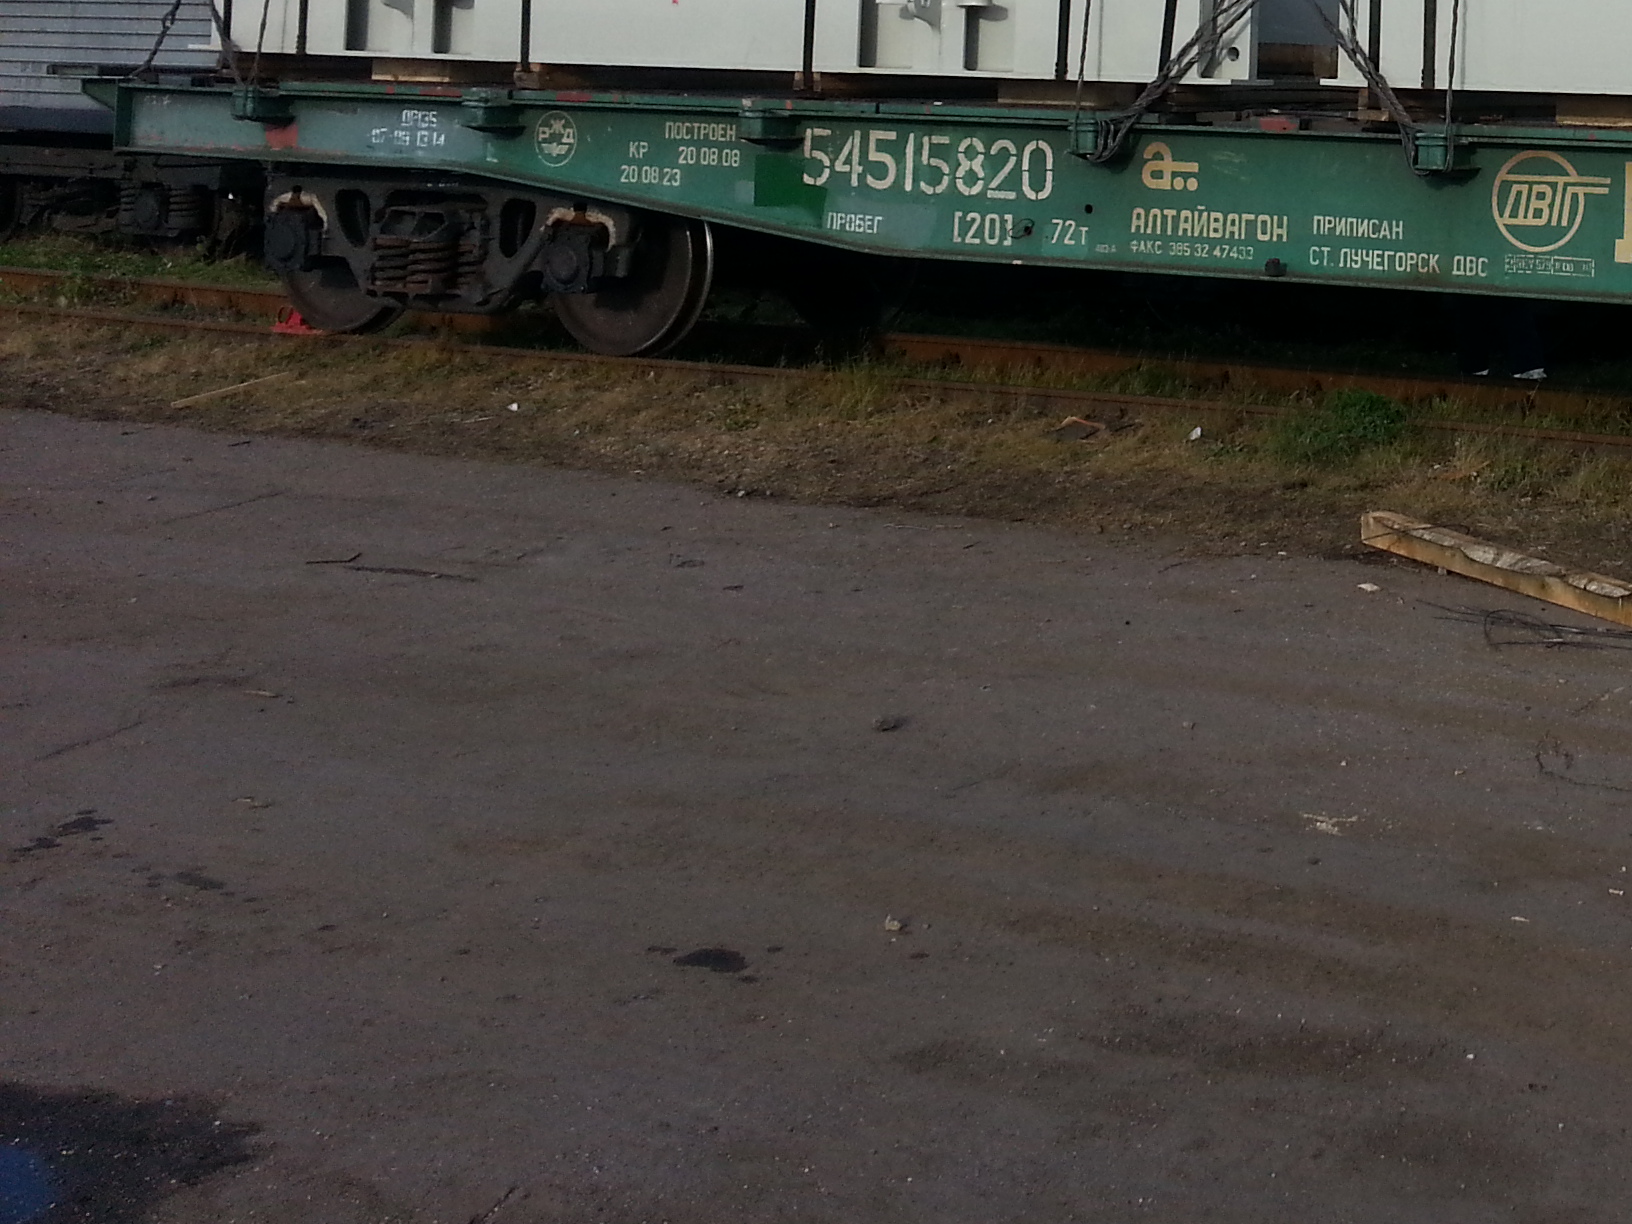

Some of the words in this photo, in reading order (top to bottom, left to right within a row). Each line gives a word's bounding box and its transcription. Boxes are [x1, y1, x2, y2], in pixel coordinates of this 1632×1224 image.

[538, 119, 575, 143] РЖД
[665, 122, 736, 141] ПОСТРОЕН
[628, 141, 649, 159] КР
[802, 128, 1054, 200] 54515820
[826, 211, 884, 234] ПРОБЕГ
[1130, 205, 1288, 242] АЛТАЙВАГОН
[1313, 216, 1403, 240] ПРИПИСАН
[1130, 240, 1163, 255] ФАКС
[1194, 244, 1209, 257] 32
[1309, 246, 1334, 267] СТ.
[1339, 248, 1441, 273] ЛУЧЕГОРСК
[1452, 255, 1489, 277] ДВС
